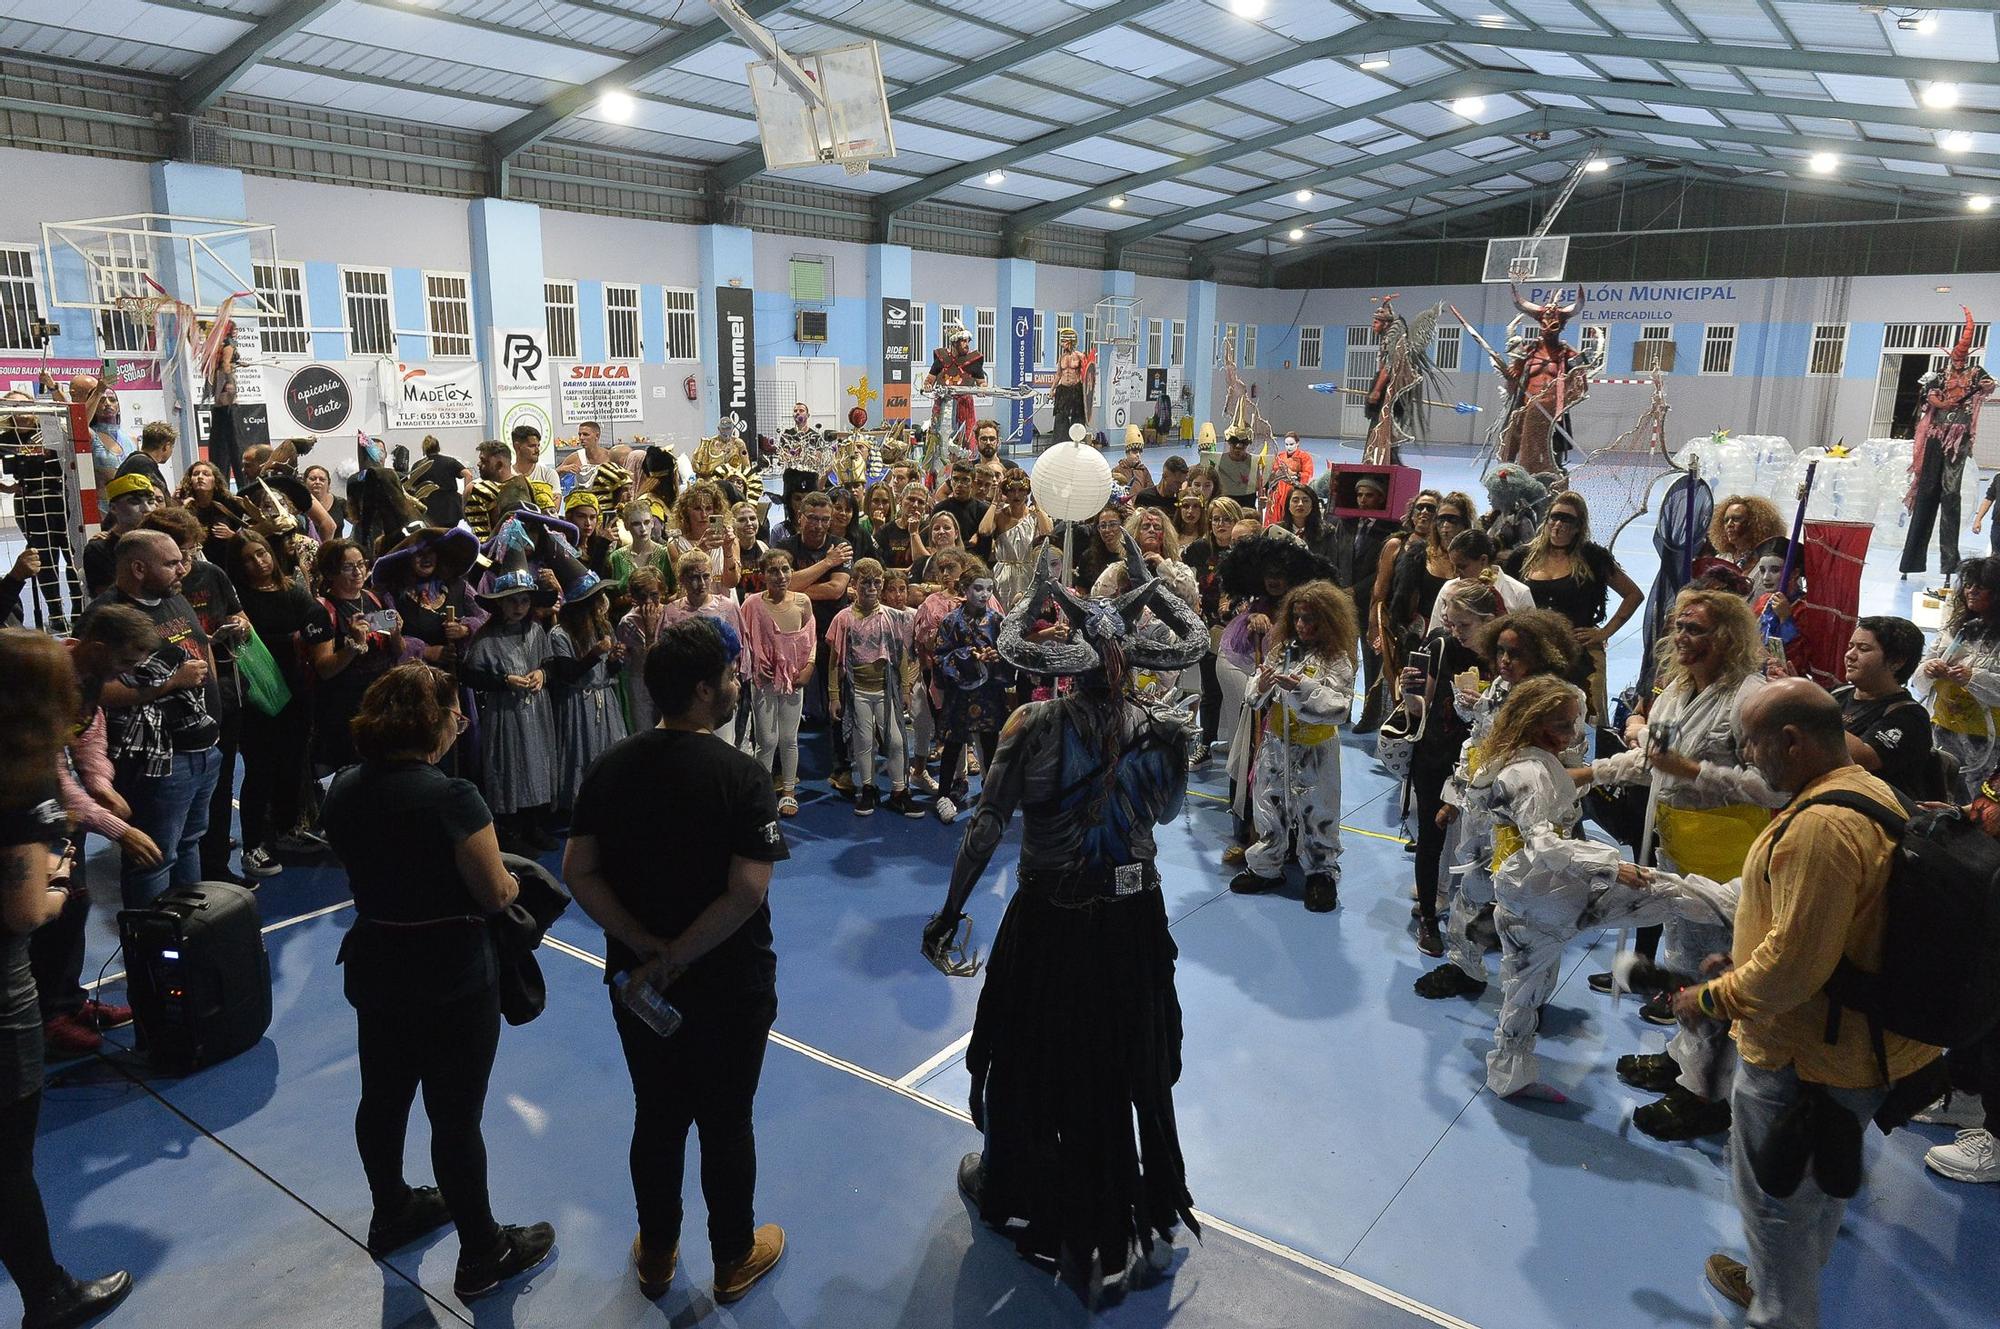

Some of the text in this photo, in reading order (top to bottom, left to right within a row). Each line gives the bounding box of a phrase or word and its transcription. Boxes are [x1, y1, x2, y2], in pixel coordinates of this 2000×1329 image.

[1530, 284, 1736, 302] PABELÓN MUNICIPAL
[1582, 310, 1672, 320] EL MERCADILLO
[727, 316, 746, 408] hummel
[570, 366, 630, 378] SILCA
[1034, 374, 1055, 384] CANTER
[290, 379, 341, 404] Tapicería
[886, 396, 908, 408] KTM
[306, 399, 342, 422] Peñate
